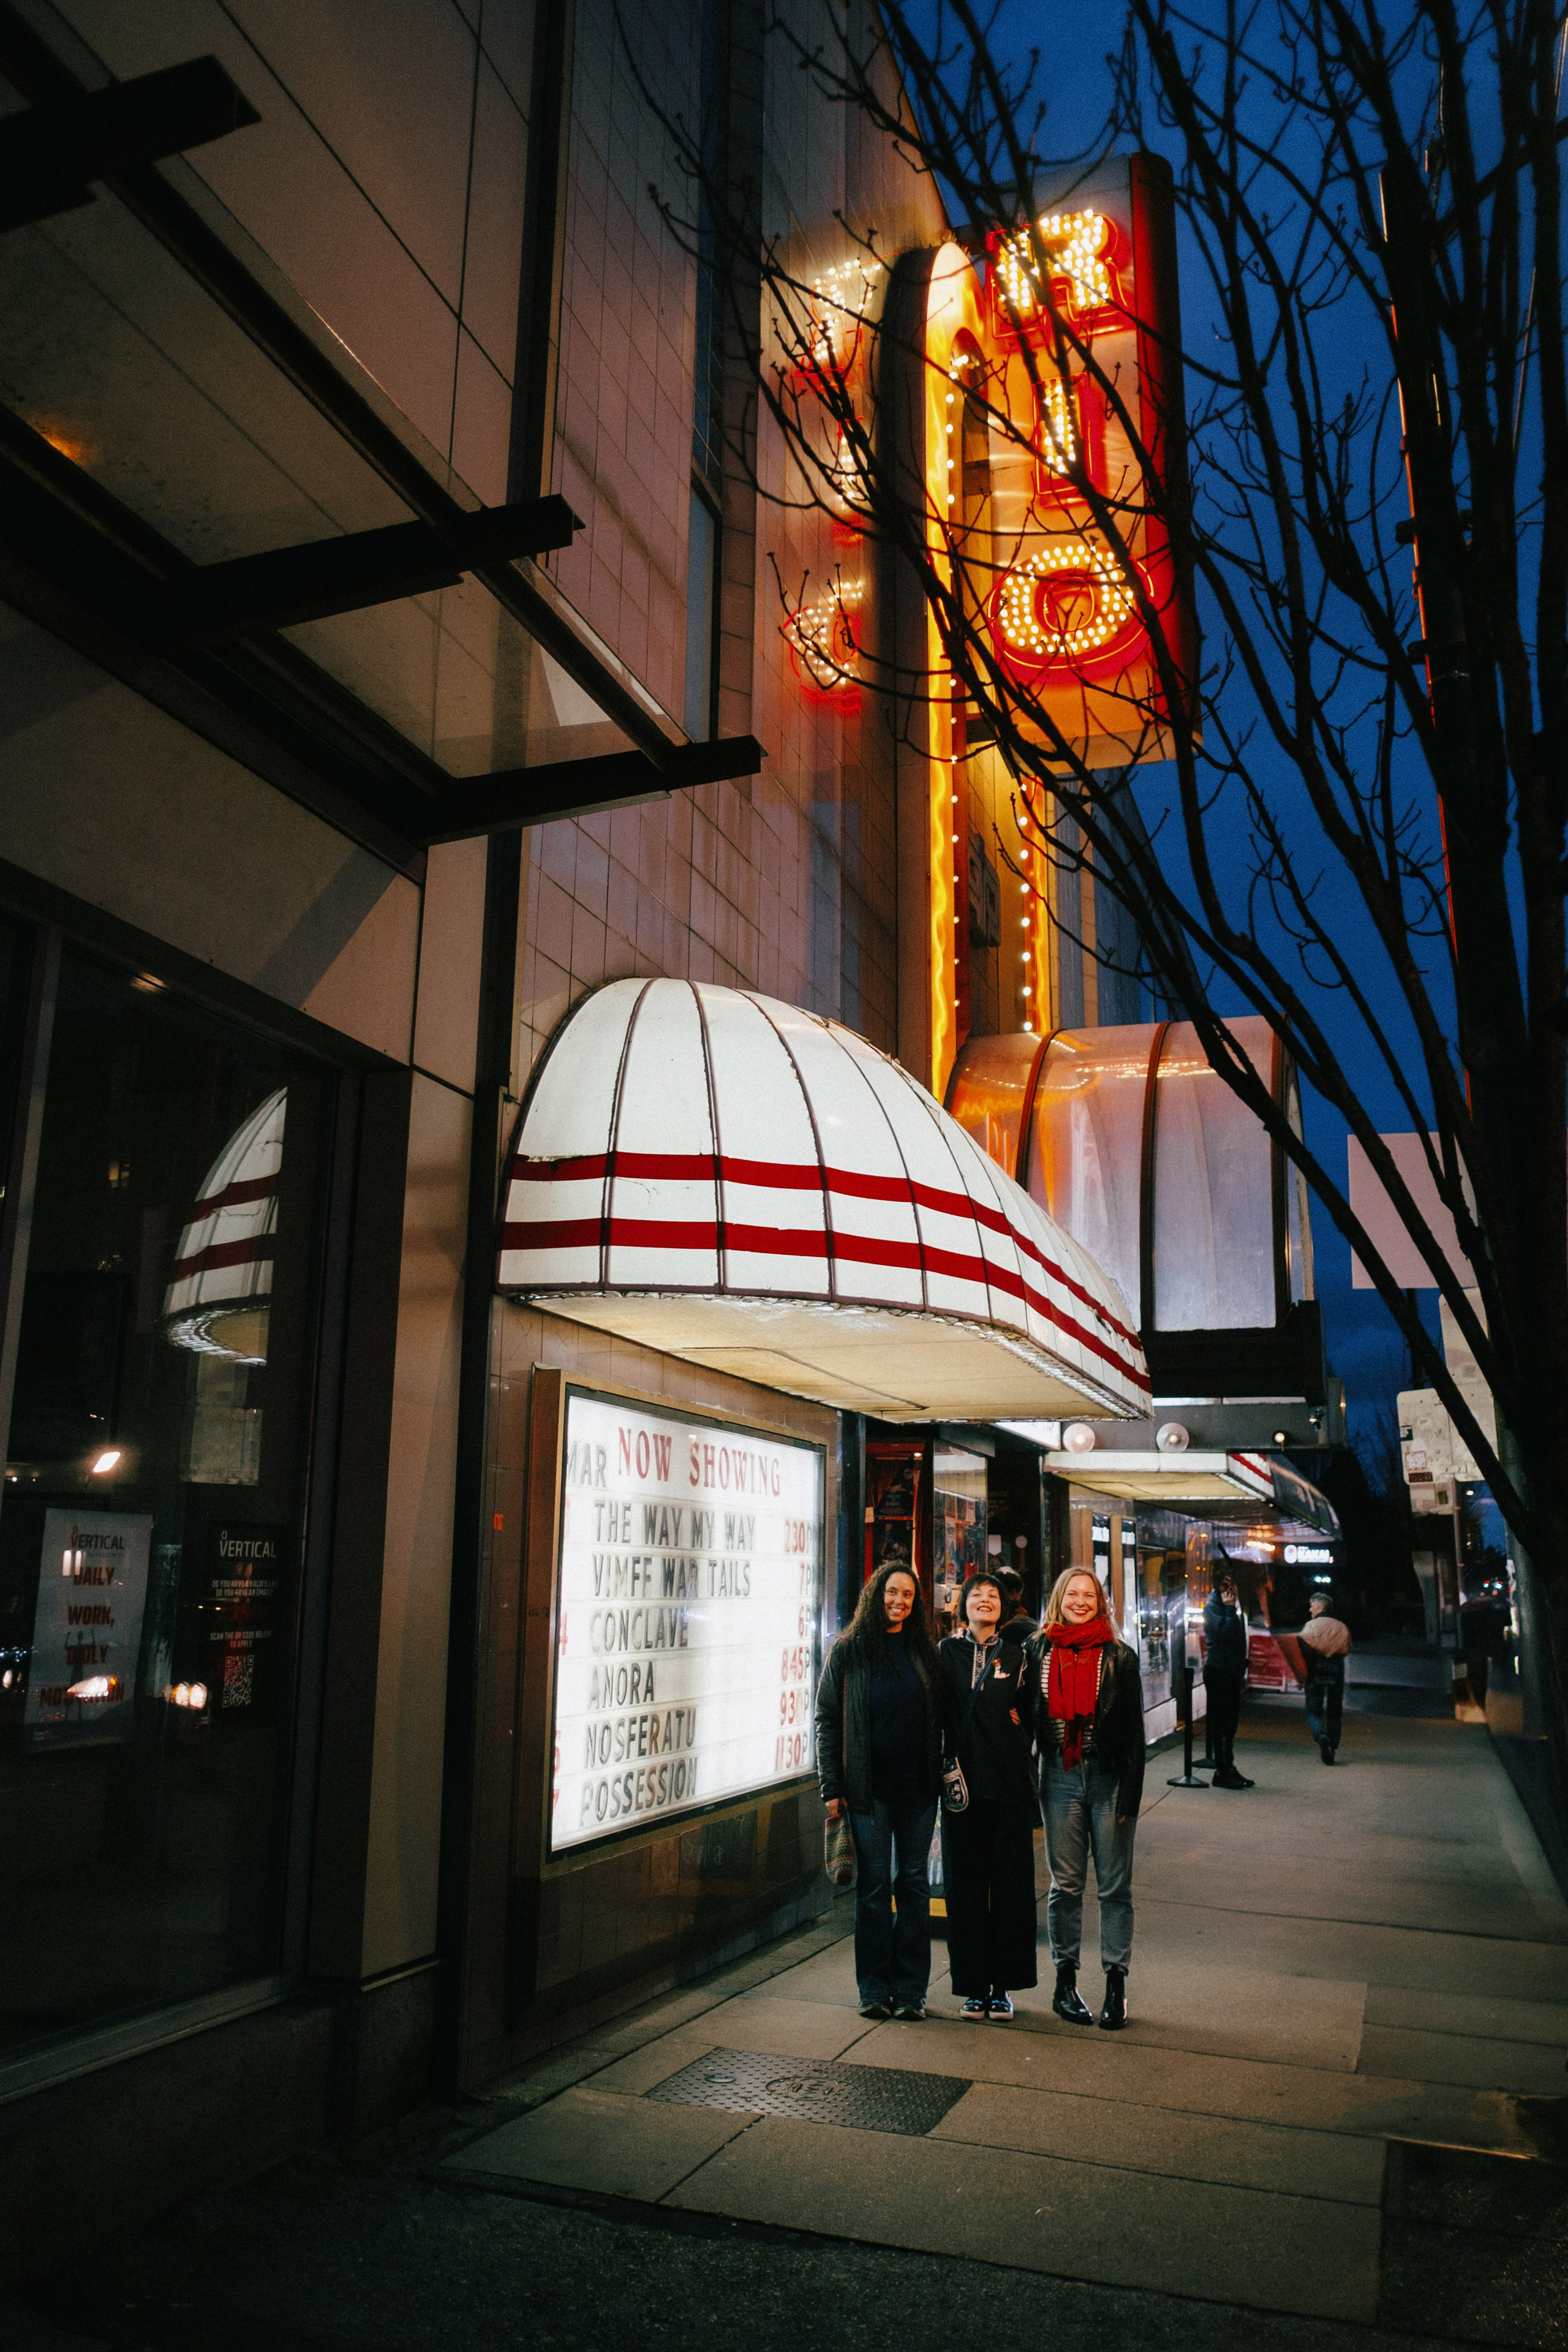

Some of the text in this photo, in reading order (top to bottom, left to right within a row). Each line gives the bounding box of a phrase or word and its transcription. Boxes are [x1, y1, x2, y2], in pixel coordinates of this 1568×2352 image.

[618, 1427, 780, 1497] NOW SHOWING
[70, 1532, 126, 1550] VERTICAL
[594, 1499, 631, 1544] THE
[643, 1504, 682, 1547] WAY
[692, 1510, 715, 1549] MY
[725, 1513, 755, 1550] WAY
[785, 1518, 813, 1555] 230P
[219, 1540, 277, 1558] VERTICAL
[73, 1566, 116, 1586] DAILY
[592, 1553, 751, 1598] VIMFF WAR TAILS
[799, 1561, 812, 1596] 7P
[67, 1605, 115, 1627] WORK,
[589, 1607, 689, 1653] CONCLAVE
[798, 1604, 812, 1640] 6P
[210, 1632, 224, 1640] SCAN
[236, 1640, 253, 1648] APPLY
[781, 1646, 810, 1682] 845P
[587, 1660, 655, 1710] ANORA
[584, 1706, 696, 1770] NOSFERATU
[775, 1730, 809, 1773] 1130P
[580, 1757, 698, 1827] POSSESSION
